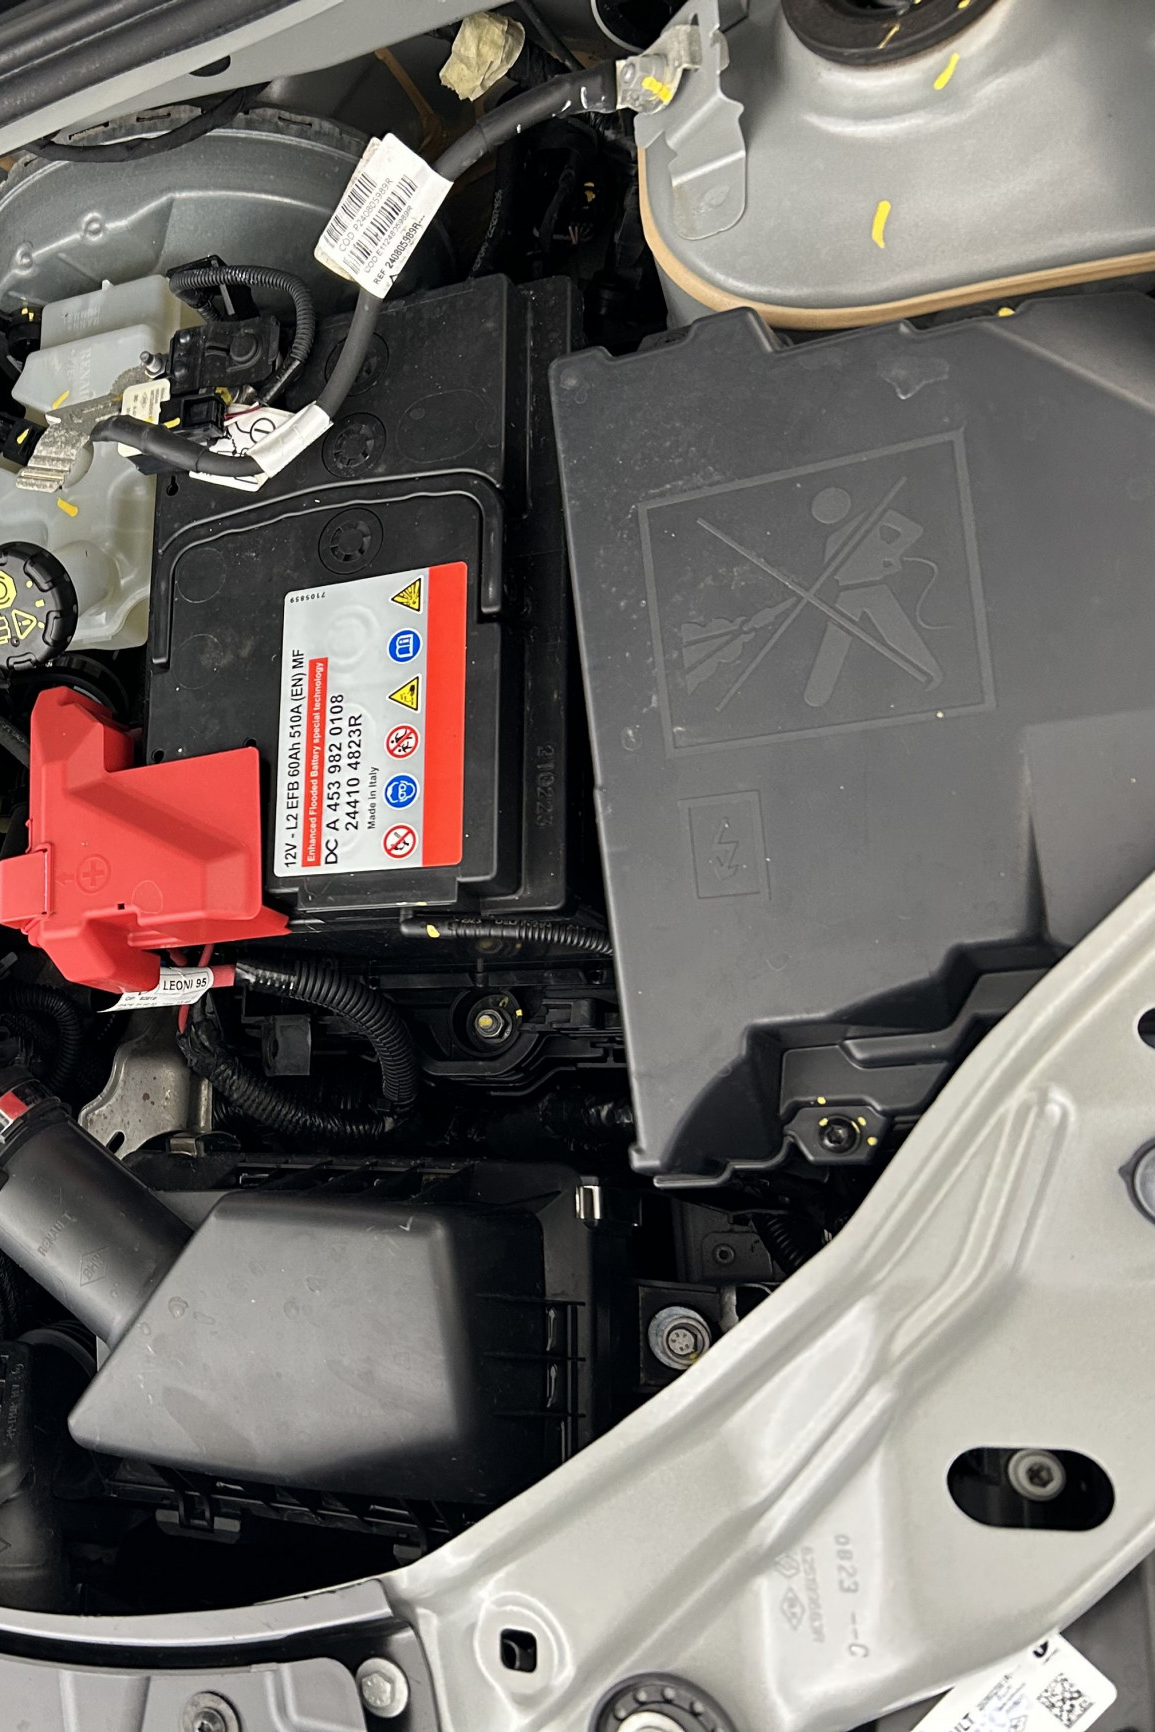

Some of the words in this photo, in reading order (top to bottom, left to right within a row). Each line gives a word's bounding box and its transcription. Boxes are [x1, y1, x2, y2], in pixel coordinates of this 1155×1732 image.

[339, 231, 355, 252] COD
[354, 177, 394, 231] P240805989R
[373, 268, 386, 285] REF
[290, 592, 326, 603] 7105859
[292, 649, 304, 669] MF
[290, 673, 307, 701] (EN)
[313, 662, 324, 710] technology
[289, 704, 302, 738] 510A
[313, 713, 324, 744] special
[329, 694, 344, 736] 0108
[347, 713, 363, 770] 4823R
[288, 742, 301, 777] 60Ah
[310, 745, 321, 777] Battery
[328, 742, 342, 774] 982
[369, 766, 379, 786] Italy
[286, 781, 299, 810] EFB
[309, 778, 319, 816] Flooded
[327, 780, 341, 812] 453
[345, 777, 360, 831] 24410
[368, 789, 377, 799] in
[285, 813, 298, 830] L2
[326, 818, 340, 831] A
[367, 803, 377, 829] Made
[284, 842, 297, 867] 12V
[307, 817, 317, 862] Enhanced
[325, 838, 338, 865] DC
[163, 979, 193, 991] LEONI
[196, 977, 207, 988] 95
[37, 1210, 72, 1257] RENAULT
